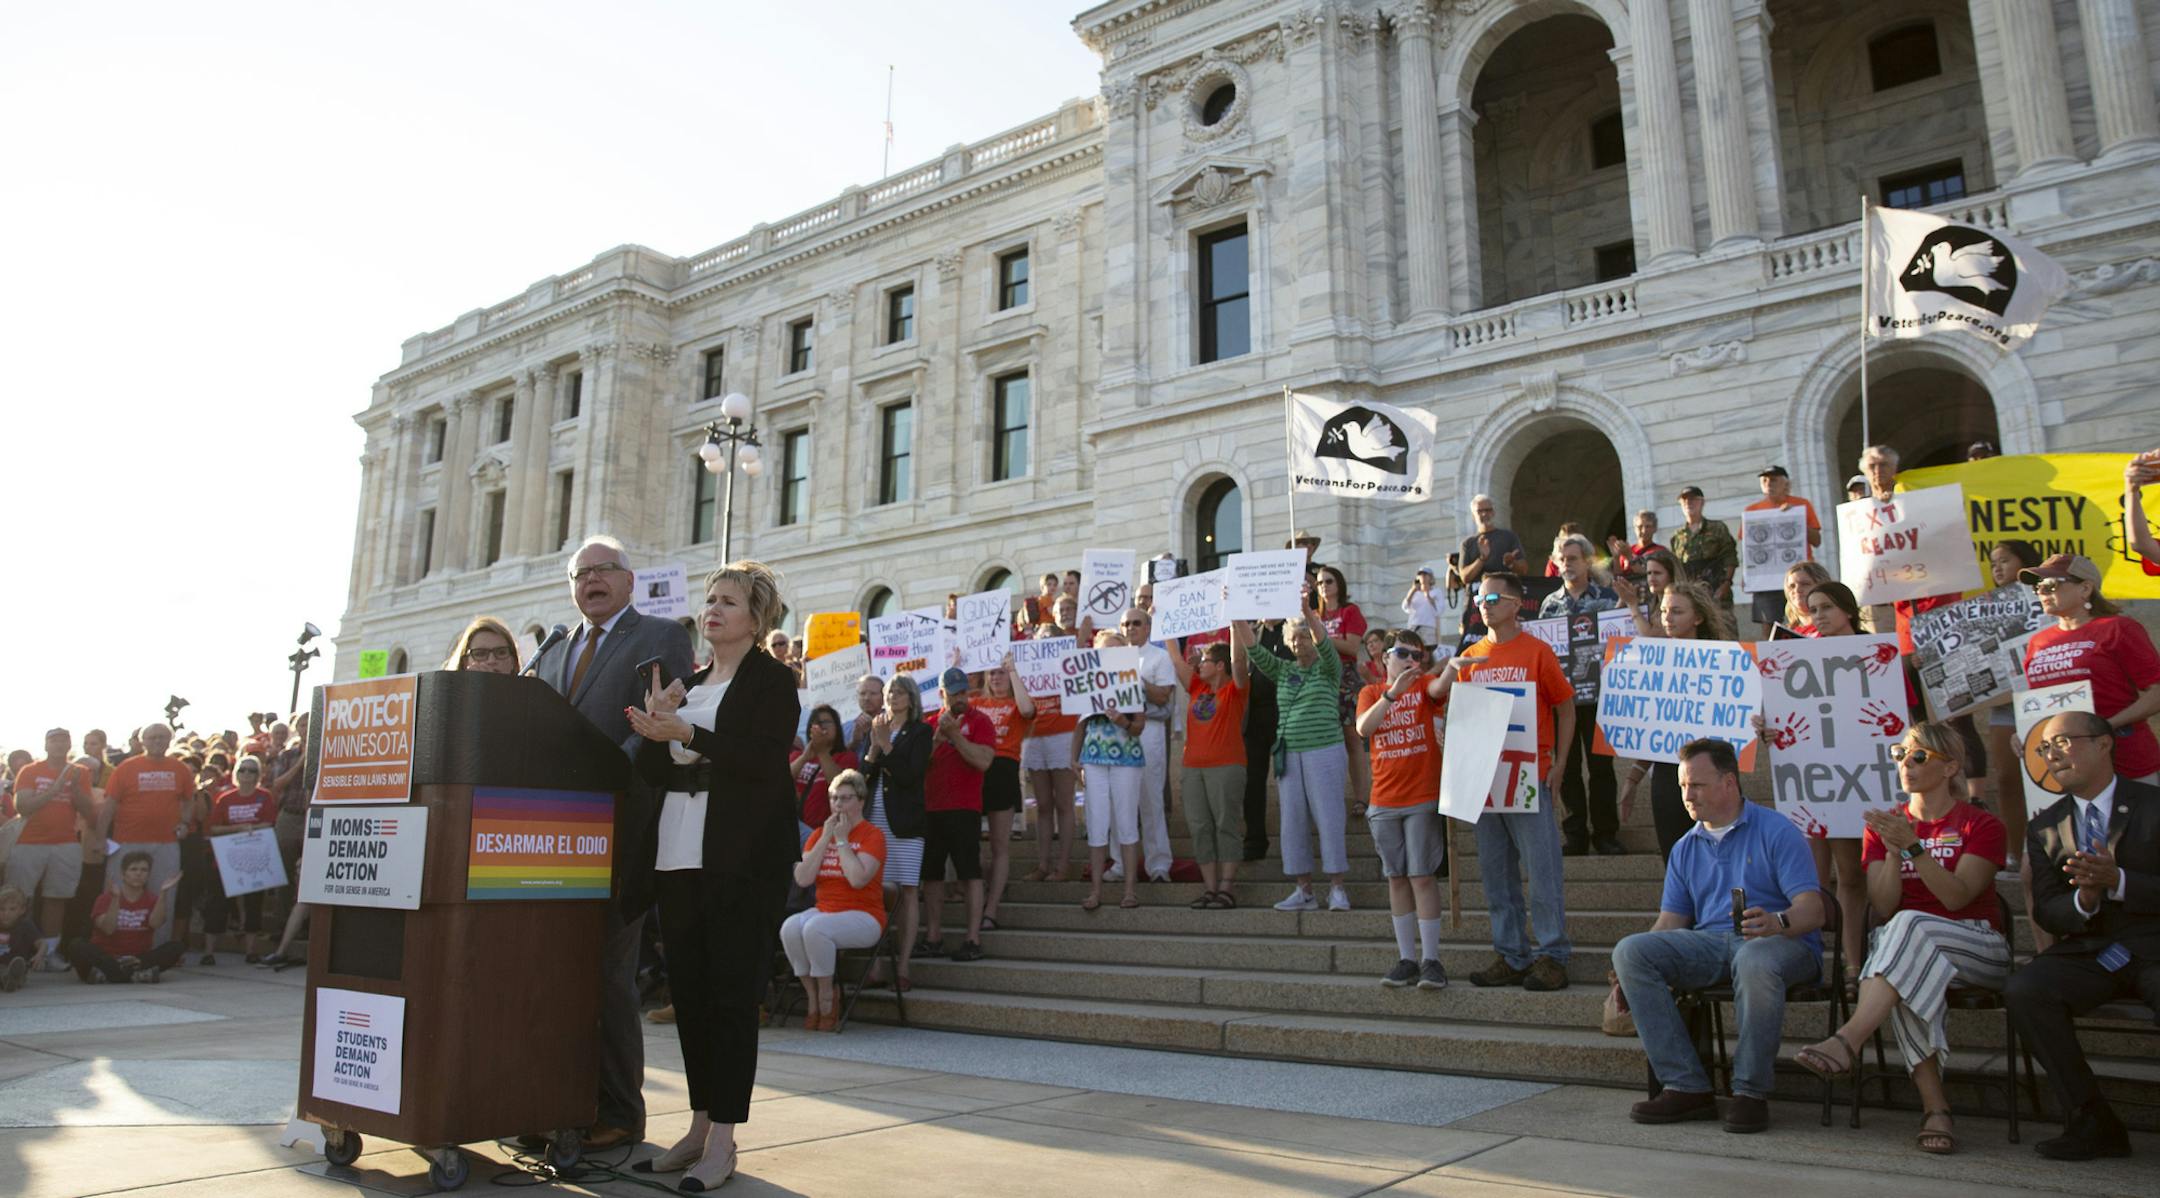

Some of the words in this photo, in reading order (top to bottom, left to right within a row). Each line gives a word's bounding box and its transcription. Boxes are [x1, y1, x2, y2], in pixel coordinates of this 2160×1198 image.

[1295, 474, 1422, 495] VeteransForPeace.org
[1970, 496, 2087, 533] NESTY
[962, 597, 1000, 622] GUNS
[1179, 590, 1206, 608] BAN
[1163, 602, 1217, 624] ASSAULT
[1913, 605, 1963, 647] WHEN
[1966, 600, 2024, 620] ENOUGH
[875, 622, 891, 634] The
[896, 616, 914, 630] only
[1160, 615, 1219, 635] WEAPONS
[875, 648, 885, 657] to
[888, 647, 908, 658] buy
[912, 641, 934, 656] than
[978, 643, 1003, 665] US
[1615, 643, 1633, 664] IF
[1638, 644, 1666, 667] YOU
[1673, 646, 1721, 671] HAVE
[1728, 649, 1752, 672] TO
[831, 653, 864, 674] Assault
[896, 657, 927, 673] GUN
[1062, 650, 1102, 676] GUN
[2028, 658, 2074, 676] ACTION
[1470, 666, 1528, 684] MINNESOTAN
[1607, 668, 1638, 691] USE
[1639, 671, 1664, 692] AN
[1667, 673, 1713, 696] AR-15
[1719, 675, 1745, 699] TO
[1783, 654, 1871, 700] am
[327, 691, 413, 732] PROTECT
[1602, 693, 1651, 722] HUNT,
[1655, 696, 1705, 725] YOU'RE
[1711, 702, 1754, 729] NOT
[1818, 702, 1836, 749] i
[324, 730, 409, 760] MINNESOTA
[1374, 729, 1404, 750] ETTING
[1603, 723, 1646, 751] VERY
[322, 773, 353, 788] SENSIBLE
[353, 773, 367, 787] GUN
[368, 771, 387, 786] LAWS
[388, 771, 407, 785] NOW!
[310, 816, 321, 829] MN
[330, 818, 373, 837] MOMS
[328, 839, 388, 860] DEMAND
[476, 832, 555, 854] DESARMAR
[557, 835, 573, 855] EL
[576, 836, 609, 856] ODIO
[325, 861, 378, 881] ACTION
[324, 883, 334, 894] FOR
[335, 884, 345, 895] GUN
[346, 885, 360, 895] SENSE
[361, 886, 367, 896] IN
[368, 887, 391, 897] AMERICA
[336, 1030, 388, 1051] STUDENTS
[335, 1045, 378, 1065] DEMAND
[334, 1060, 371, 1079] ACTION
